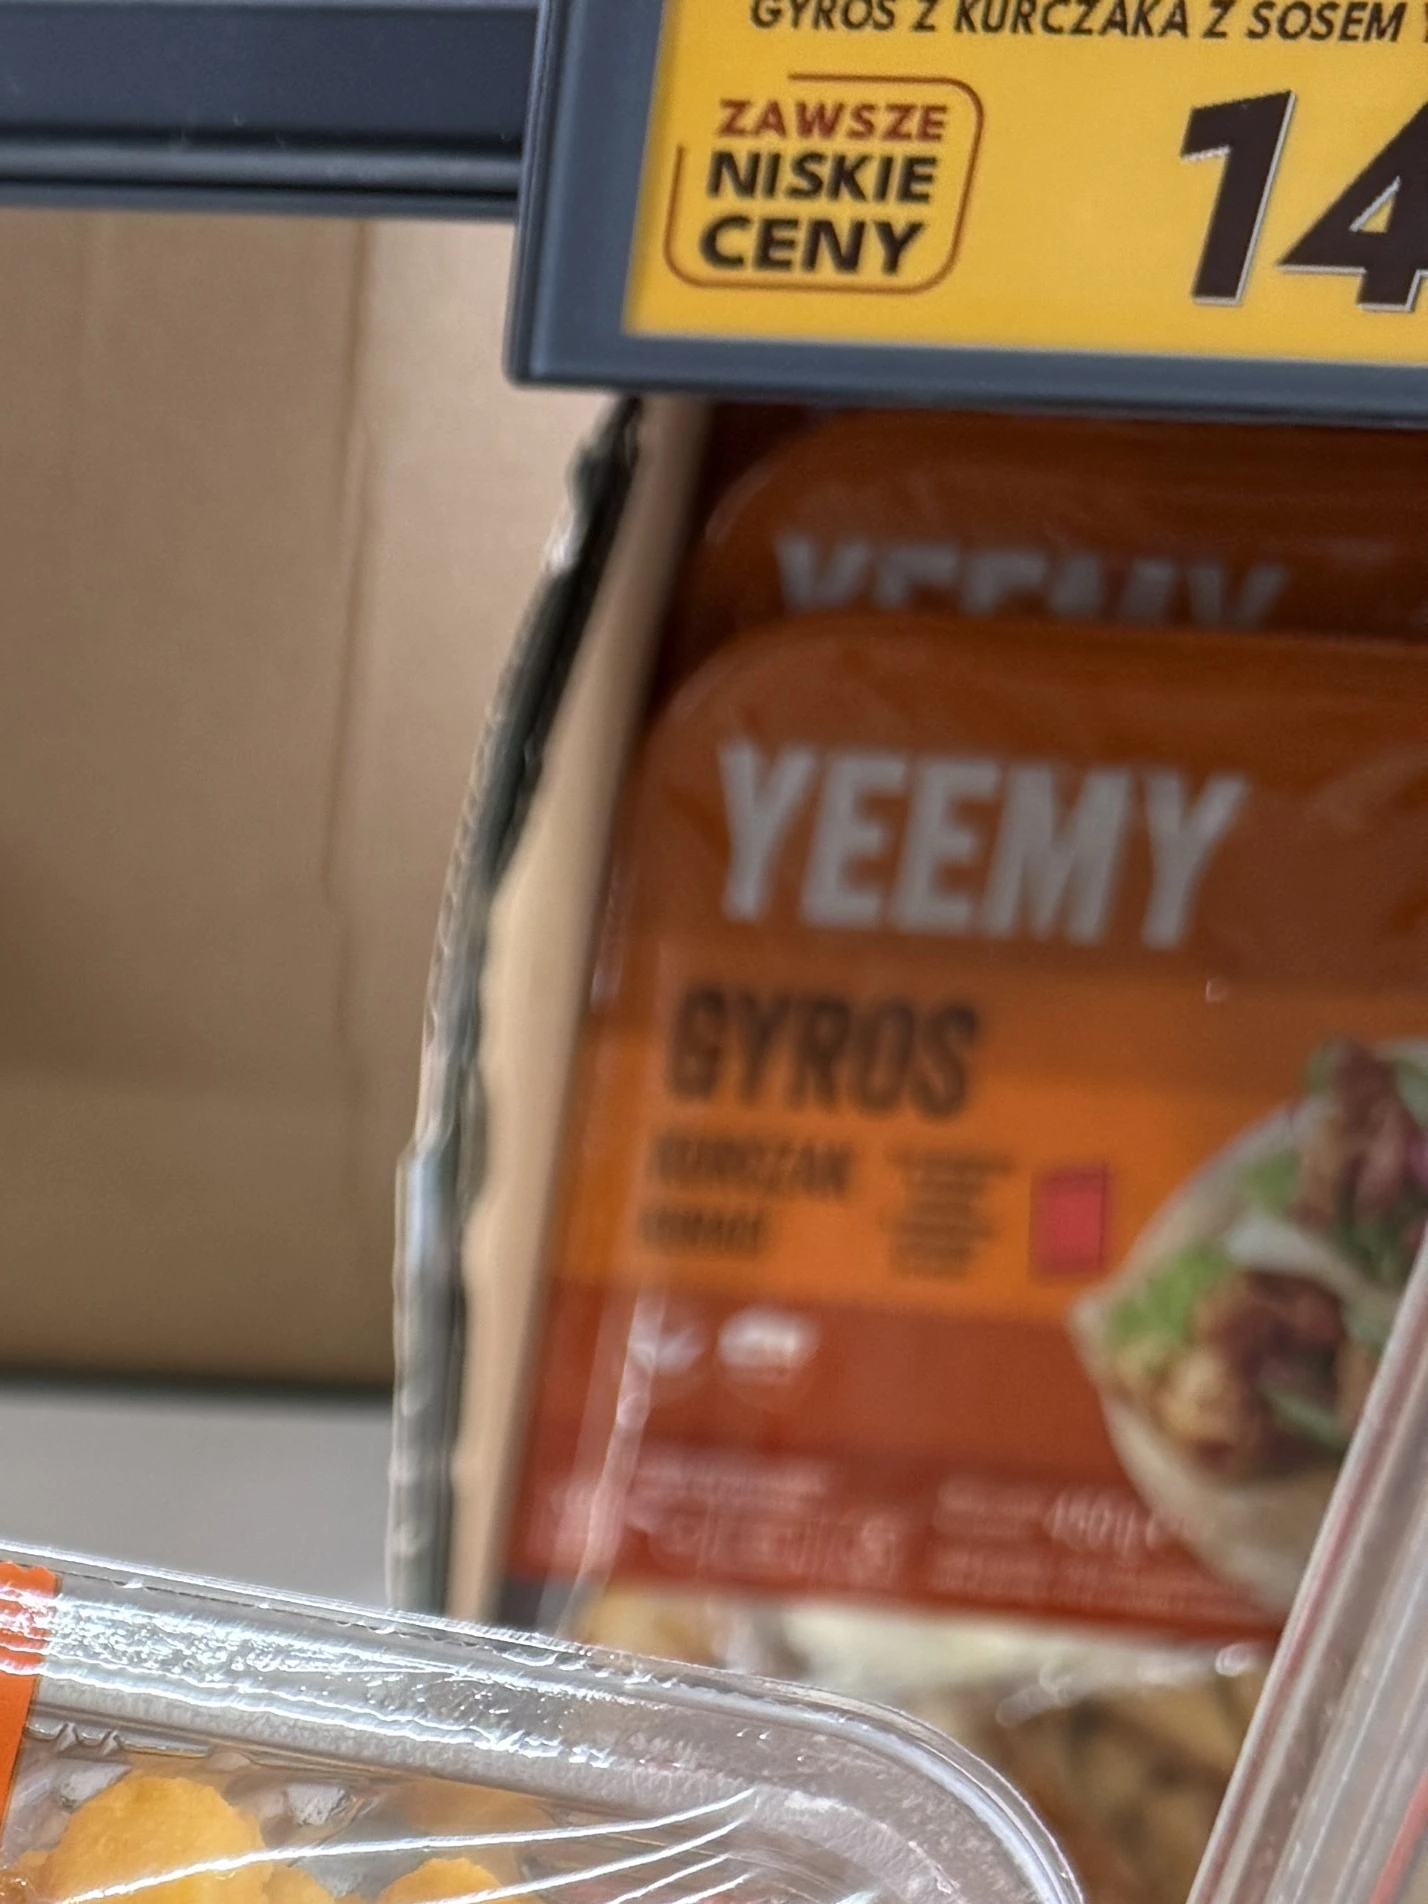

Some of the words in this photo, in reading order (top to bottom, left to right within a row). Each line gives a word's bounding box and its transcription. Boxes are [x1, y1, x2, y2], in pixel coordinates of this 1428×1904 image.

[750, 0, 895, 30] GYROS
[912, 0, 936, 32] Z
[953, 0, 1189, 38] KURCZAKA
[1202, 0, 1234, 39] Z
[1246, 1, 1407, 42] SOSEM
[717, 99, 949, 142] ZAWSZE
[706, 152, 939, 205] NISKIE
[698, 215, 926, 277] CENY
[718, 744, 1246, 947] YEEMY
[667, 986, 980, 1119] GYROS
